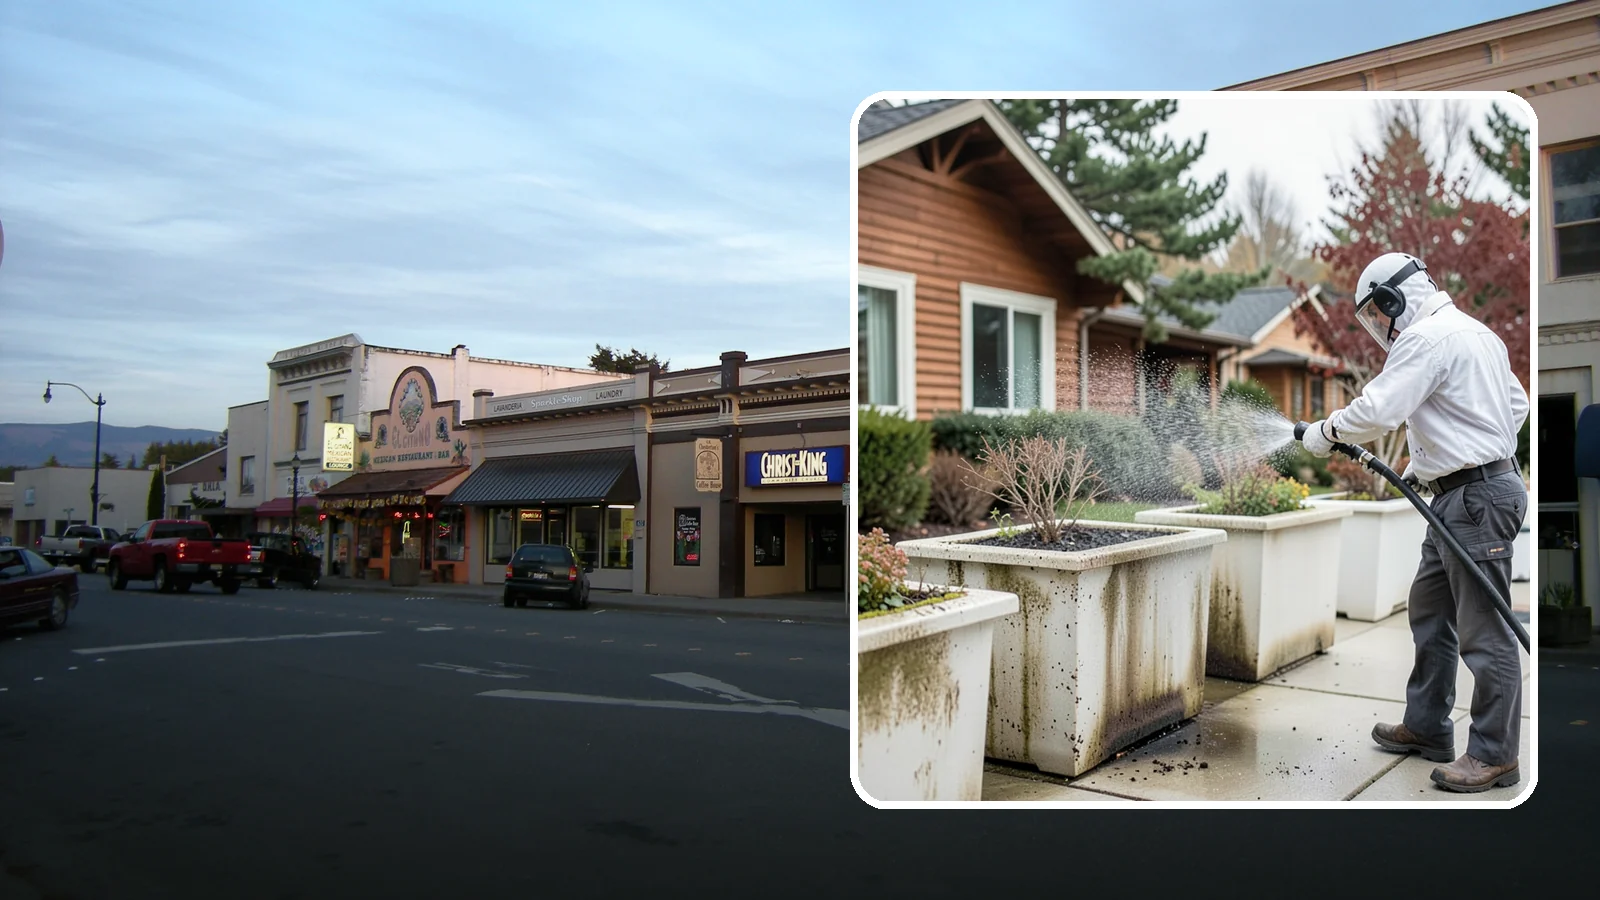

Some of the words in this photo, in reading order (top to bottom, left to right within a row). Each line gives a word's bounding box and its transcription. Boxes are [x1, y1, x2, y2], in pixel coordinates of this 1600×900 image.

[595, 389, 623, 400] LAUNDRY
[493, 402, 522, 412] LAVANDERIA
[530, 397, 561, 408] Sparkle
[562, 394, 582, 404] Shop
[373, 454, 397, 464] MEXICAN
[398, 451, 433, 463] RESTAURANT
[438, 450, 450, 459] BAR
[799, 450, 827, 476] KING
[696, 481, 709, 489] Coffee
[710, 481, 722, 489] House
